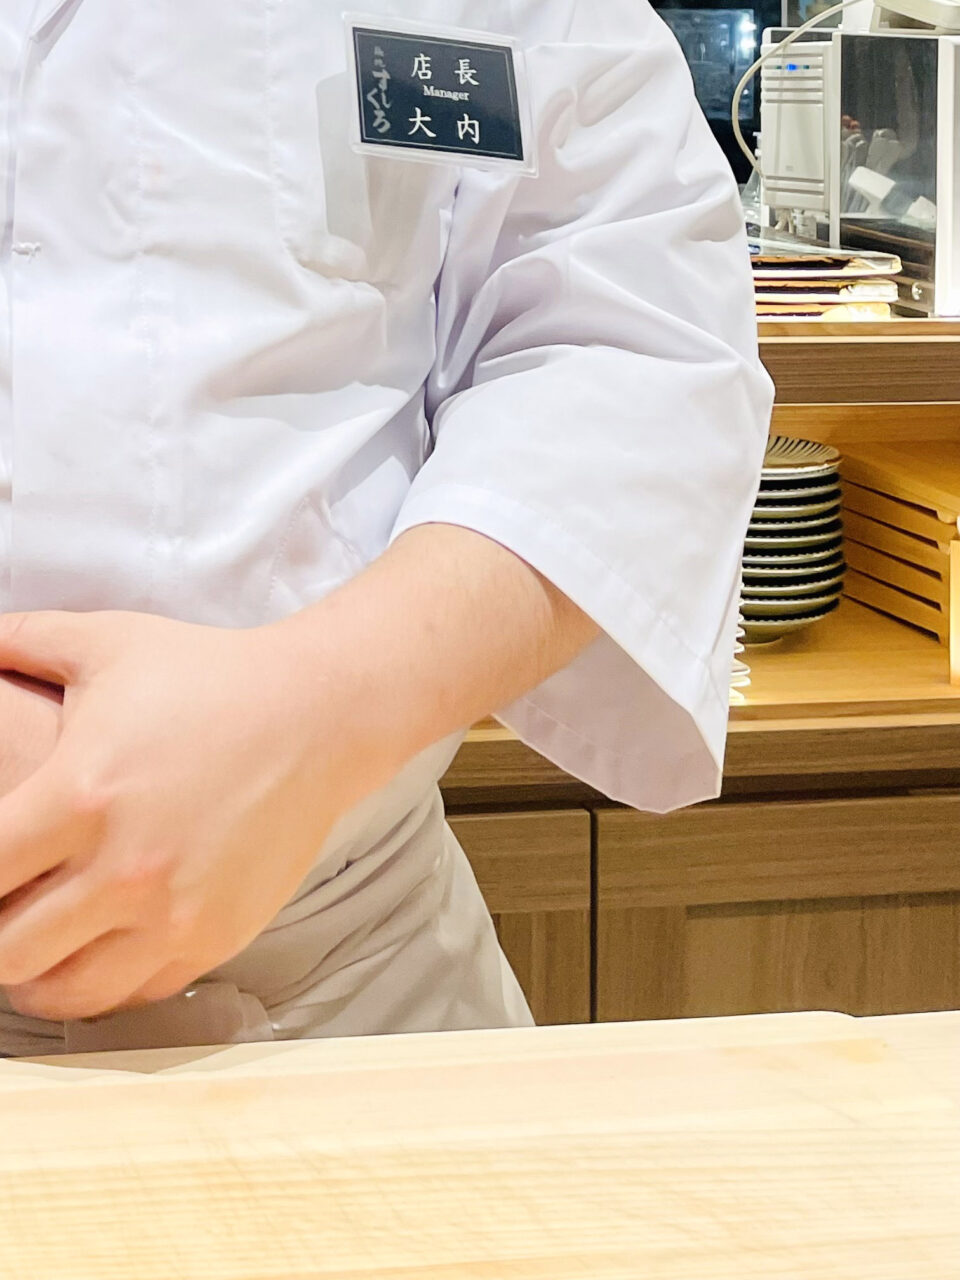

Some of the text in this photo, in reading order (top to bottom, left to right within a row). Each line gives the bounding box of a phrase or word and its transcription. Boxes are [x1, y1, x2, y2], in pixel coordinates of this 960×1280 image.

[411, 53, 480, 86] 店長
[423, 85, 470, 102] Manager
[408, 107, 480, 144] 大内
